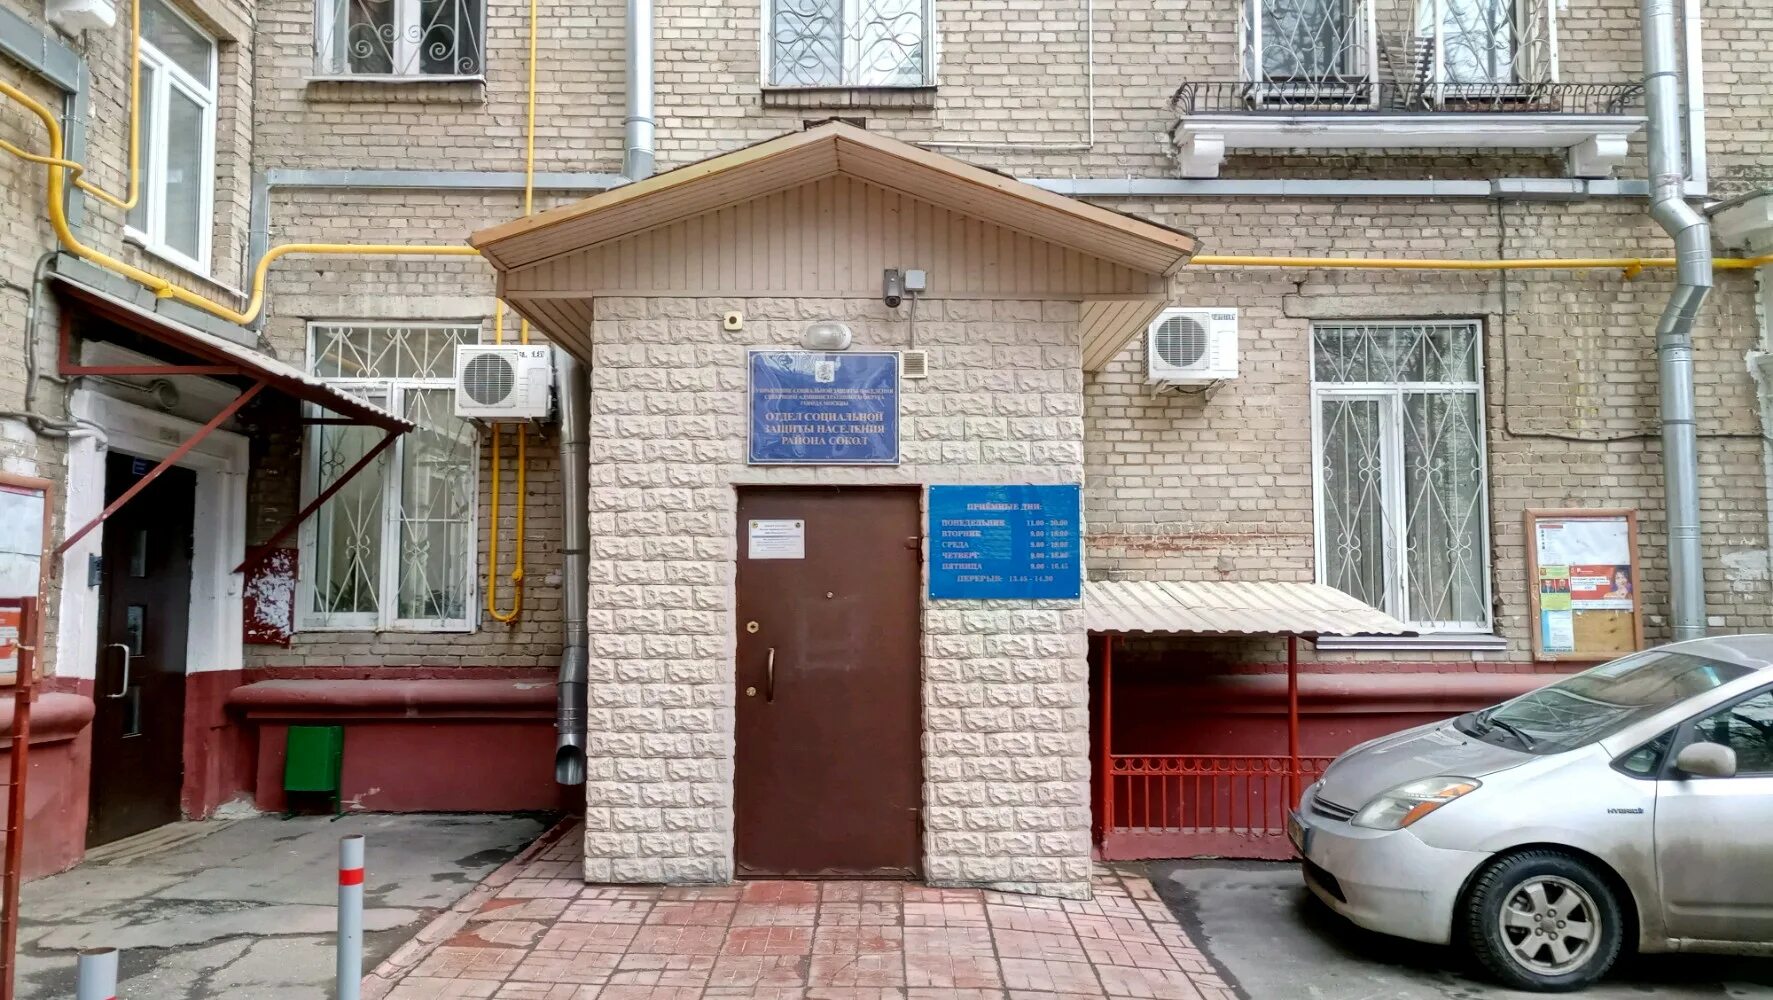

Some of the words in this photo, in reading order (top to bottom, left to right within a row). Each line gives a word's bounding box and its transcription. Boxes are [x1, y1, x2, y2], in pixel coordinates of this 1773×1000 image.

[766, 412, 802, 422] ОТДЕЛ
[804, 411, 884, 422] СОЦИАЛЬНОЙ
[764, 424, 814, 434] ЗАЩИТЫ
[817, 424, 885, 434] НАСЕЛЕНИЯ
[781, 435, 826, 445] РАЙОНА
[828, 436, 868, 445] СОКОЛ
[967, 502, 1019, 511] ПРИЁМНЫЕ
[941, 520, 1006, 528] ПОНЕДЕЛЬНИК
[941, 530, 982, 538] ВТОРНИК
[941, 541, 969, 549] СРЕДА
[941, 552, 980, 560] ЧЕТВЕРГ
[941, 563, 983, 571] ПЯТНИЦА
